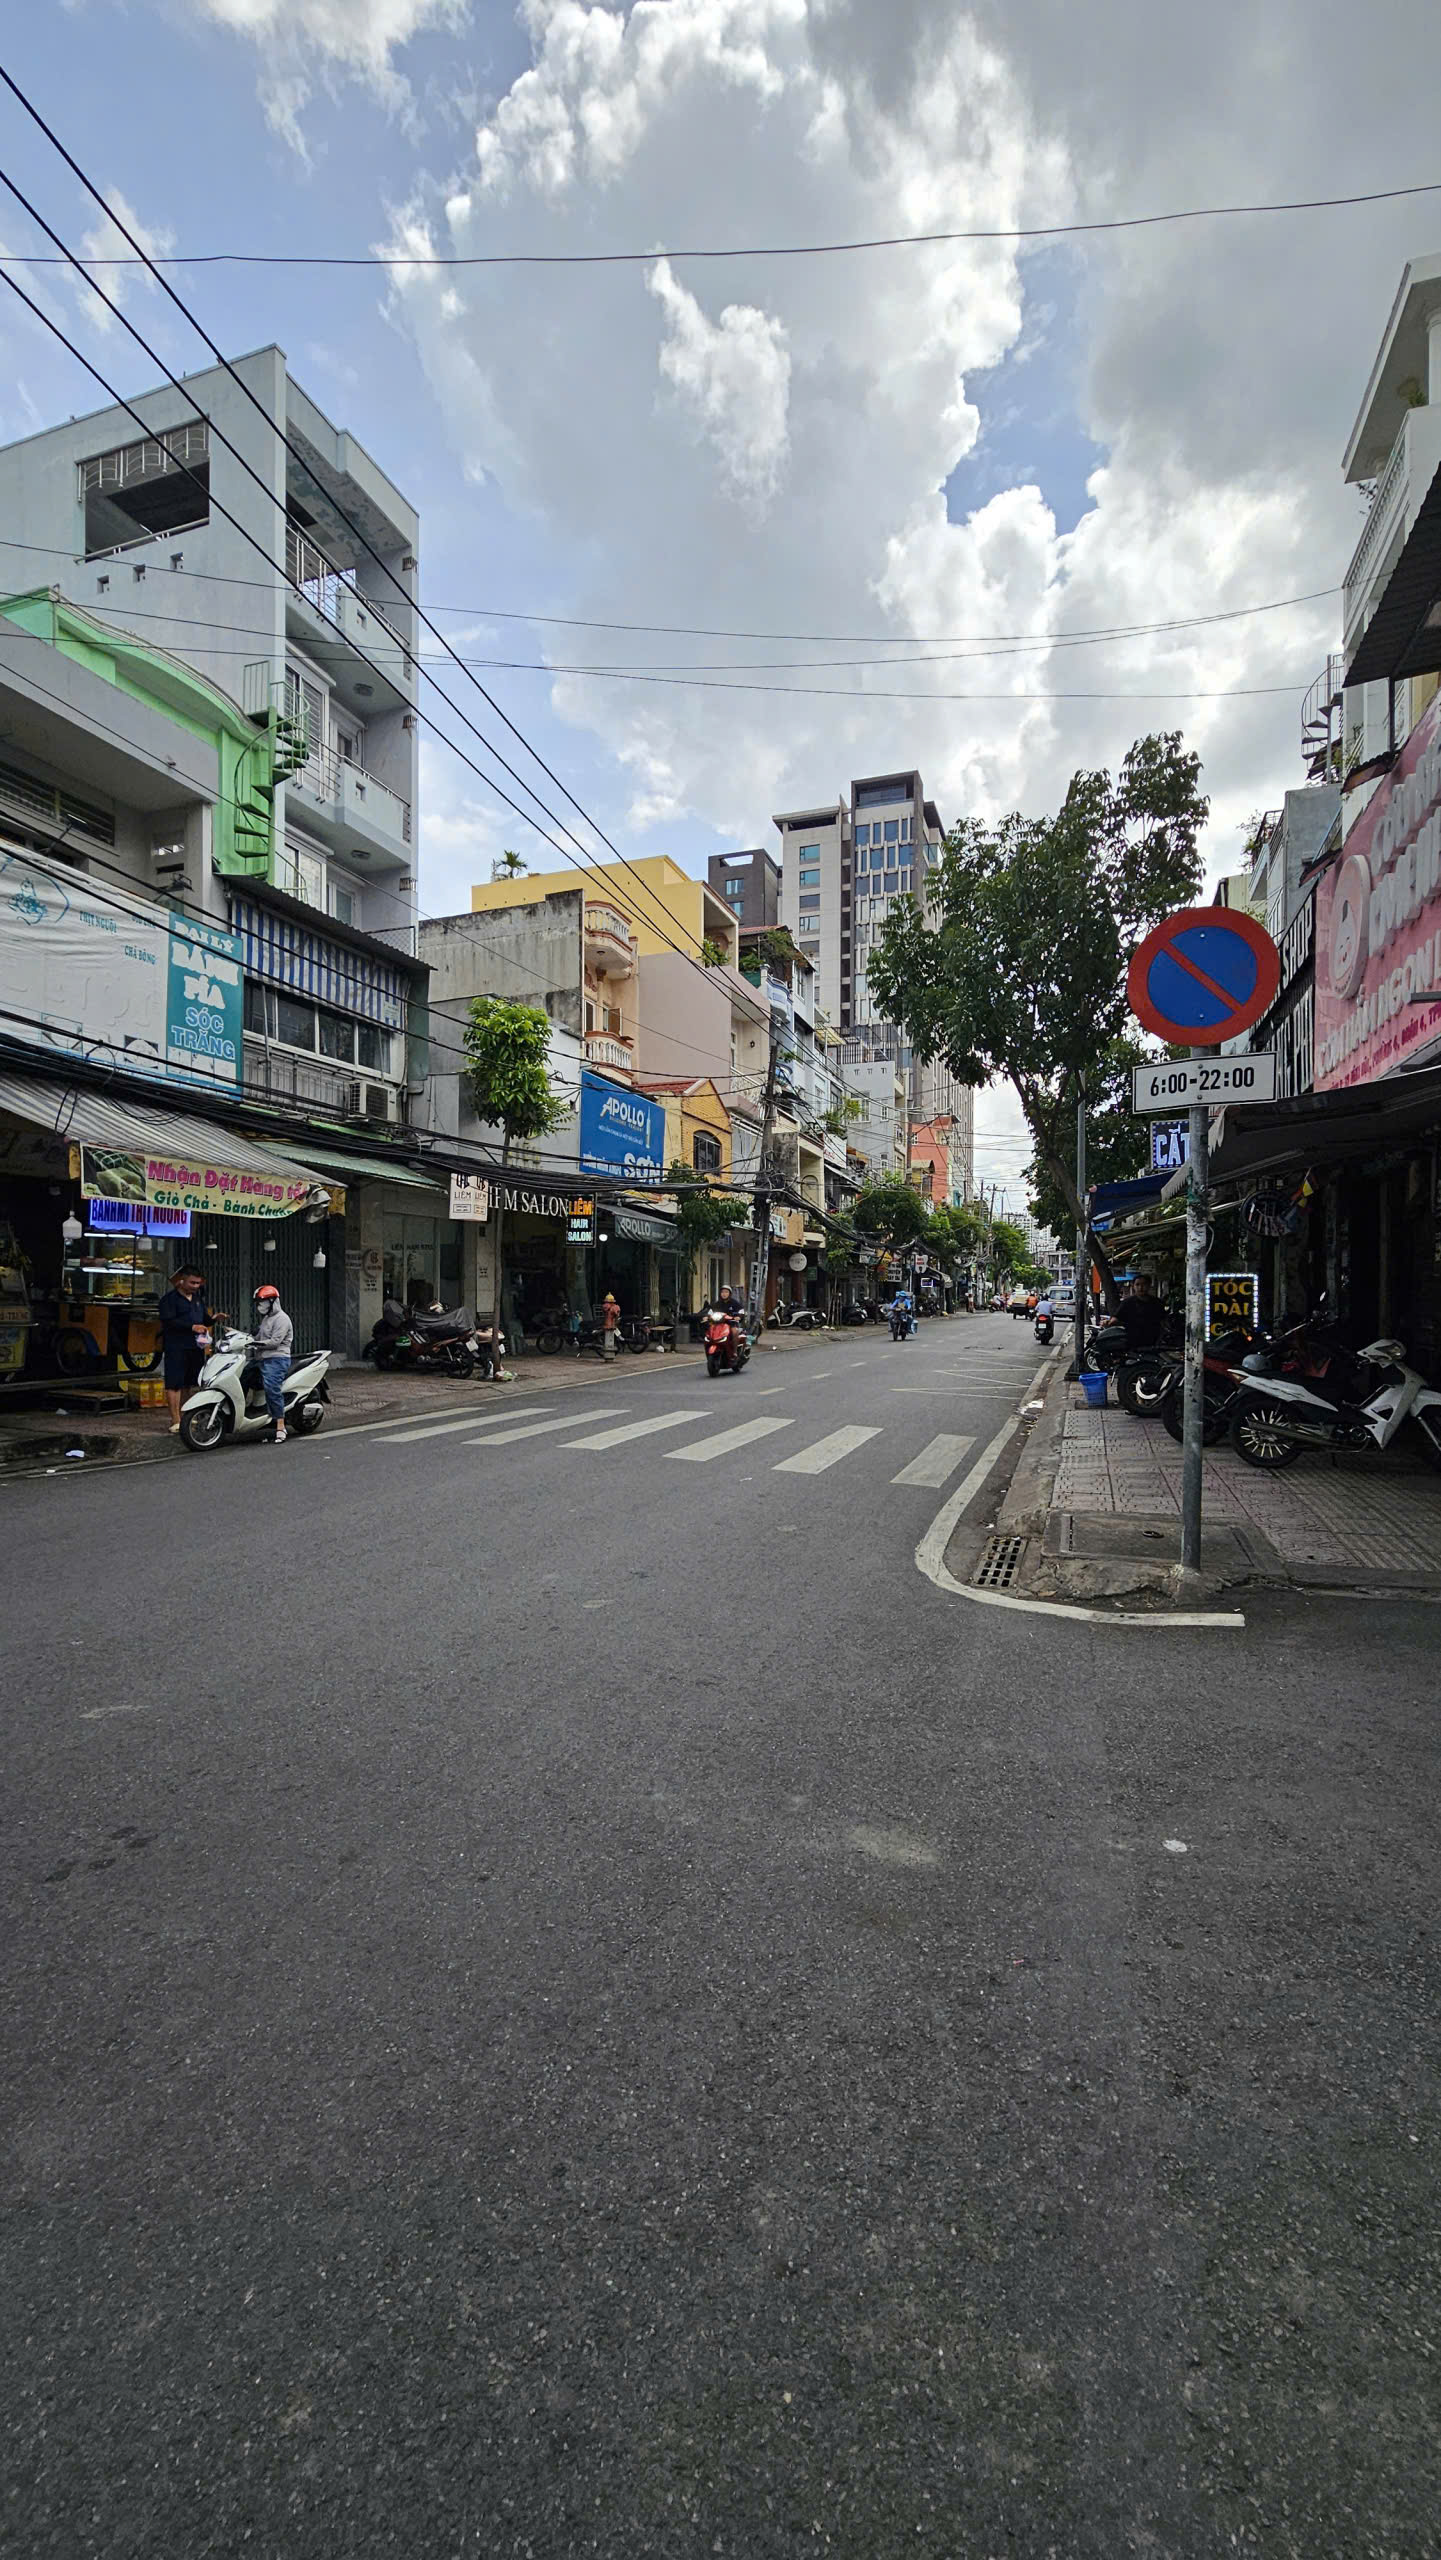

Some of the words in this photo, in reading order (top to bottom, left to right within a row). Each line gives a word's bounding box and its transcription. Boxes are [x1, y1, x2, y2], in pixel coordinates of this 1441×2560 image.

[1282, 894, 1312, 990] SHOP
[185, 1006, 225, 1034] SÓC
[171, 1025, 236, 1060] TRĂNG
[1150, 1066, 1255, 1097] 6:00-22:00
[600, 1096, 646, 1128] APOLLO
[148, 1160, 201, 1191] Nhận
[204, 1169, 239, 1197] Đặt
[239, 1175, 284, 1201] Hàng
[153, 1191, 181, 1207] Giò
[183, 1194, 211, 1211] Chả
[223, 1200, 256, 1216] Bánh
[454, 1190, 472, 1200] LIÊM
[520, 1191, 569, 1219] SALON
[568, 1197, 593, 1216] LIÊM
[570, 1218, 589, 1229] HAIR
[619, 1216, 651, 1237] APOLLO
[567, 1231, 592, 1243] SALON
[1212, 1278, 1253, 1296] TÓC
[1214, 1298, 1250, 1316] DÀI
